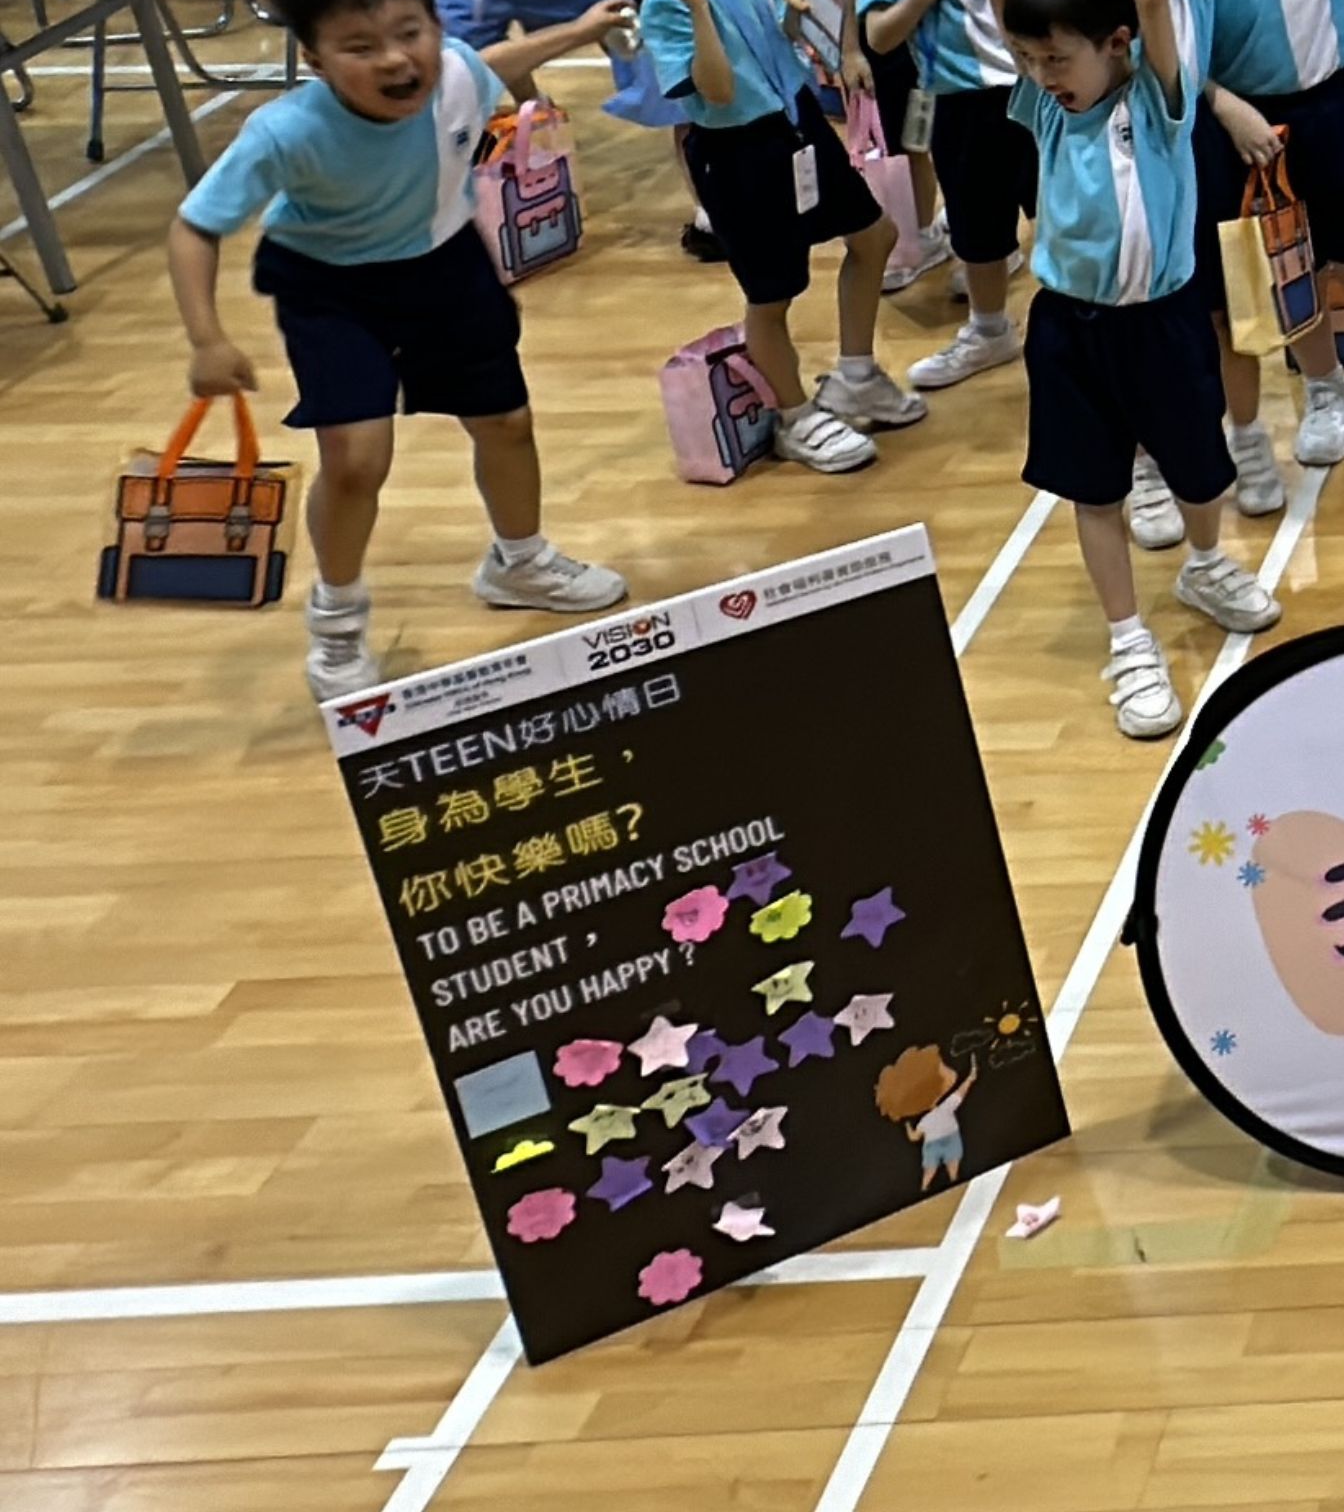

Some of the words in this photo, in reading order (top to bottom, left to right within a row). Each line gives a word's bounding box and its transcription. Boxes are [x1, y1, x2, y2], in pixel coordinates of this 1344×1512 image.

[582, 611, 671, 650] VISION
[587, 629, 677, 671] 2030
[417, 926, 460, 961] TO
[466, 908, 509, 947] BE
[516, 900, 539, 930] A
[541, 853, 667, 919] PRIMACY
[673, 816, 785, 874] SCHOOL
[430, 936, 570, 1008] STUDENT
[449, 1008, 508, 1053] ARE
[511, 984, 574, 1027] YOU
[579, 948, 672, 1005] HAPPY
